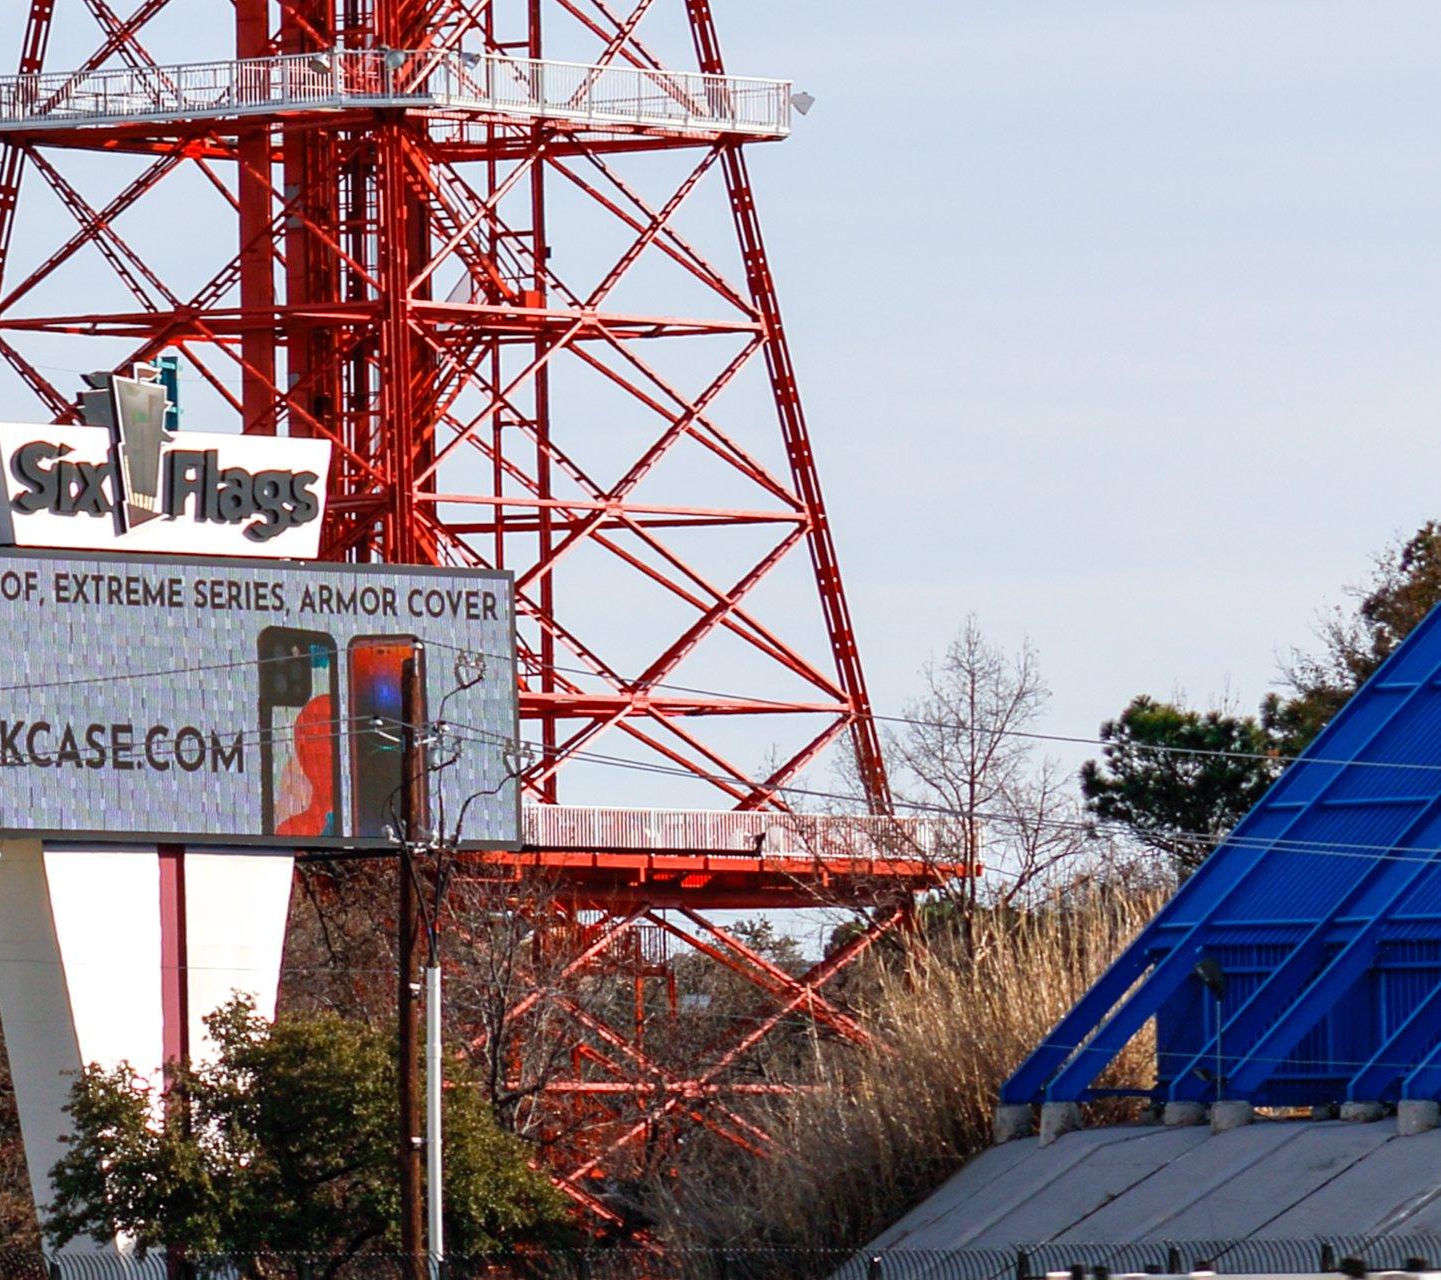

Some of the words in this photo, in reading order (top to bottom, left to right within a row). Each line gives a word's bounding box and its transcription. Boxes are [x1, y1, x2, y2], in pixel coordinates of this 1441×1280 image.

[10, 440, 115, 518] Six
[162, 448, 319, 542] Flags
[55, 572, 184, 608] EXTREME
[193, 579, 291, 617] SERIES,
[299, 584, 398, 617] ARMOR
[407, 588, 498, 621] COVER
